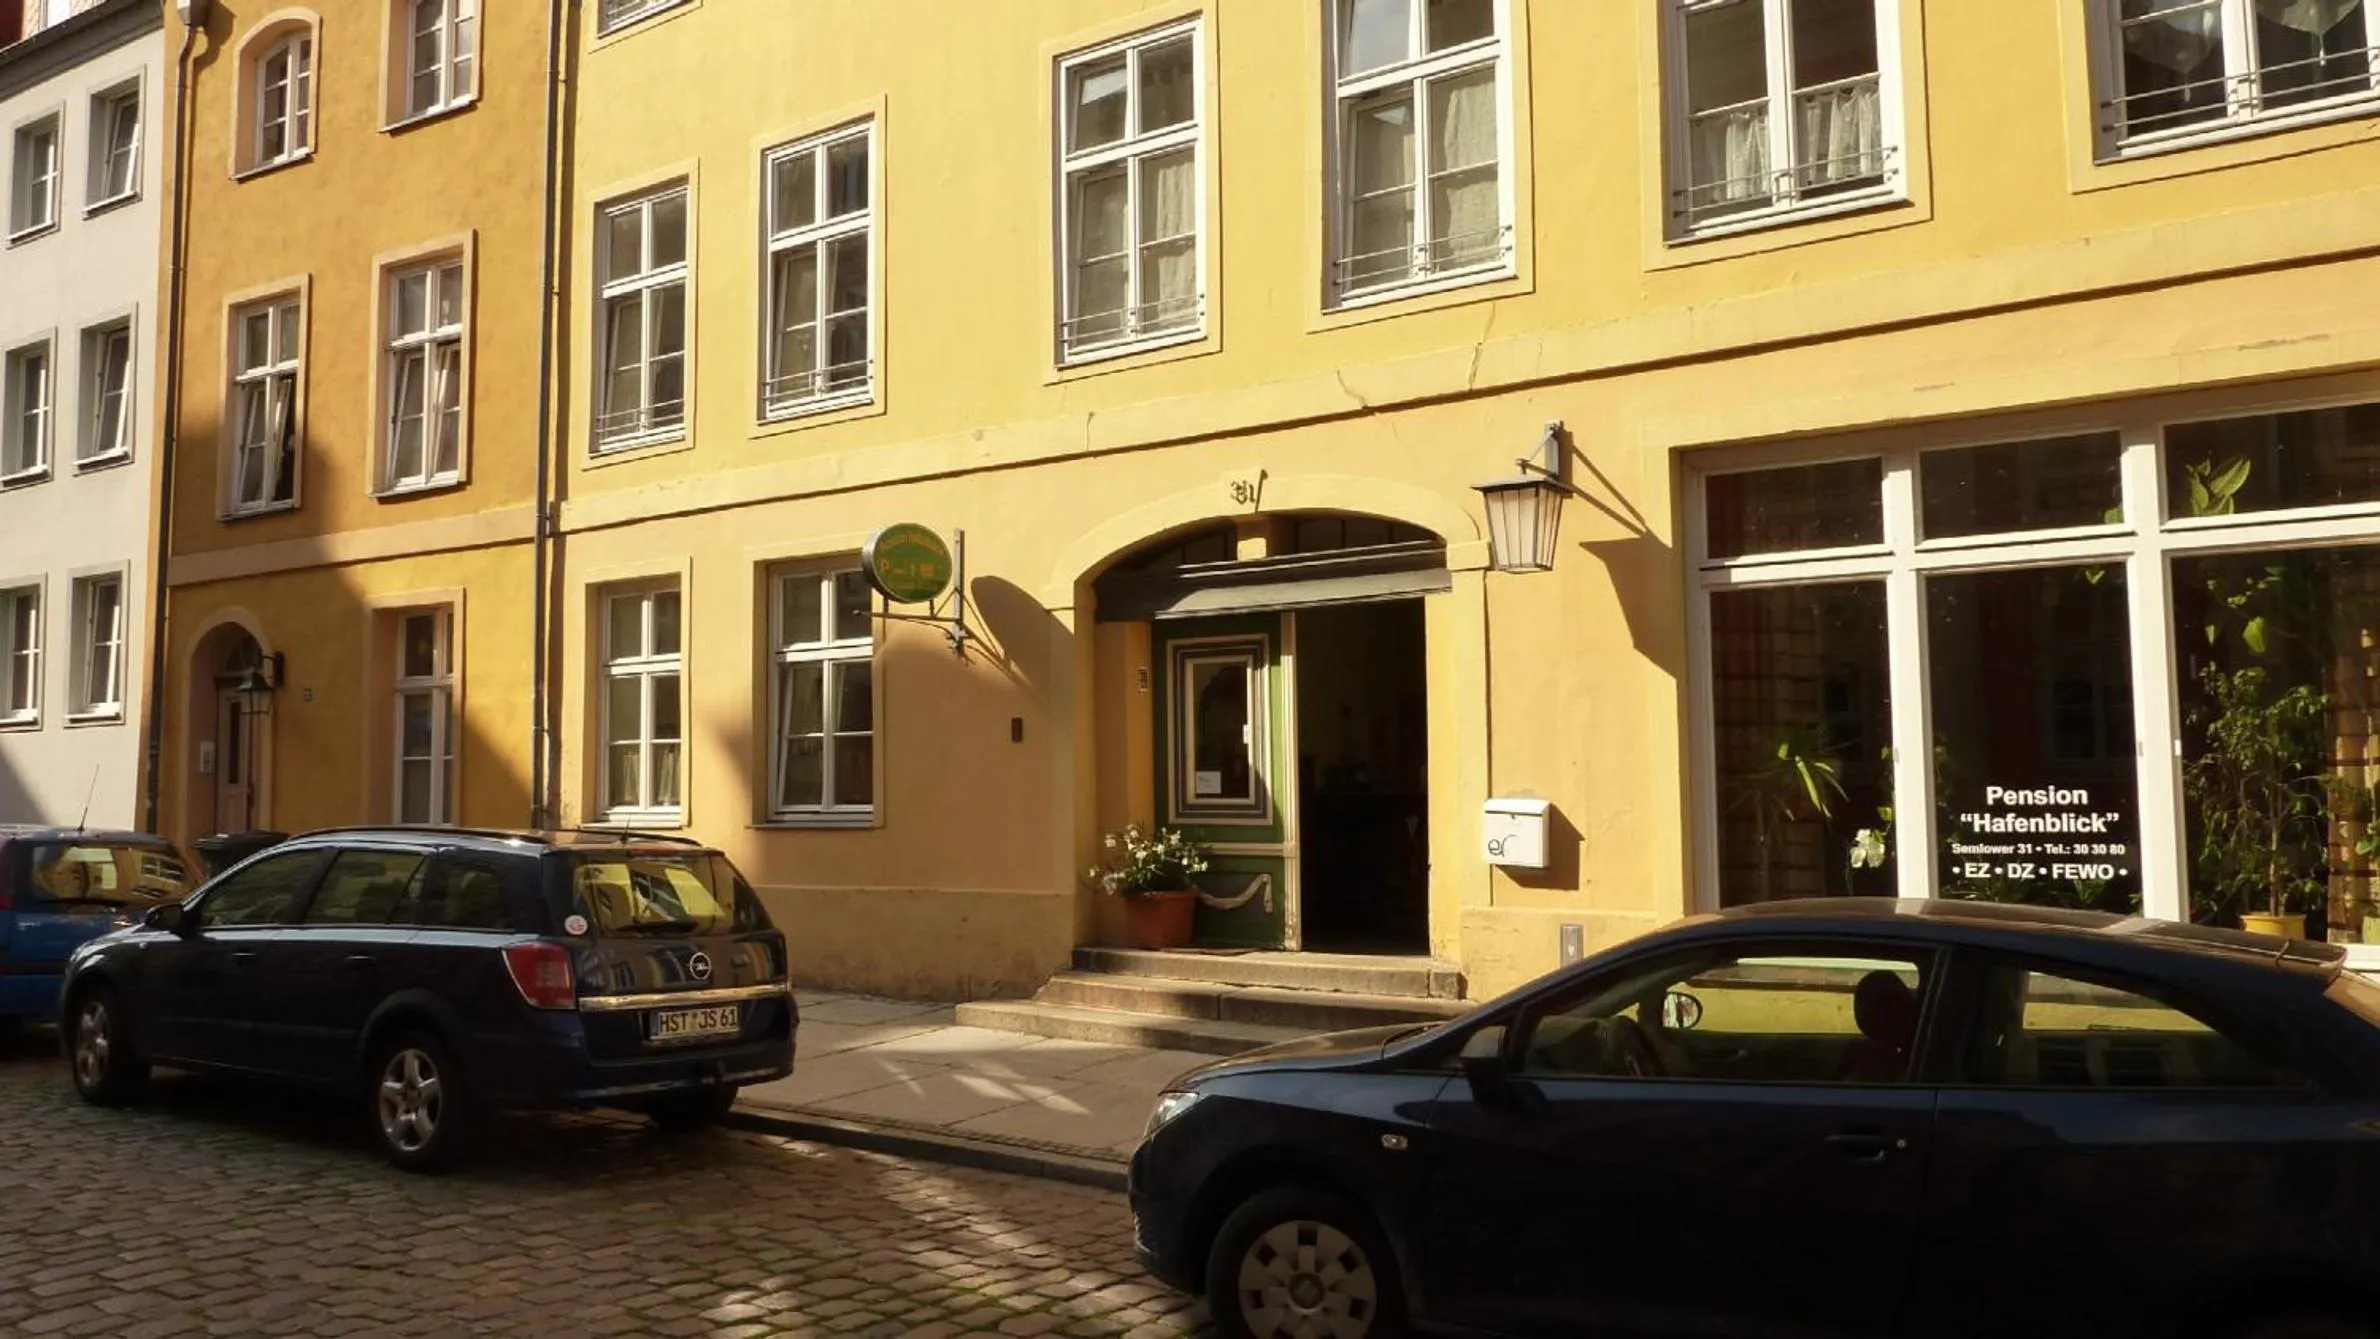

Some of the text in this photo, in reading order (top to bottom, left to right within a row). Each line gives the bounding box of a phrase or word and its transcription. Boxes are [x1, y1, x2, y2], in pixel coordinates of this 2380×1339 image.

[1985, 785, 2088, 806] Pension
[1960, 812, 2119, 833] “Hafenblick”
[1951, 843, 2015, 855] Semlower
[2017, 843, 2032, 855] 31
[2073, 843, 2089, 855] 30
[2091, 843, 2107, 855] 30
[2109, 843, 2126, 855] 80
[1965, 862, 2115, 880] EZ DZ FEWO
[659, 1008, 737, 1032] HST JS 61
